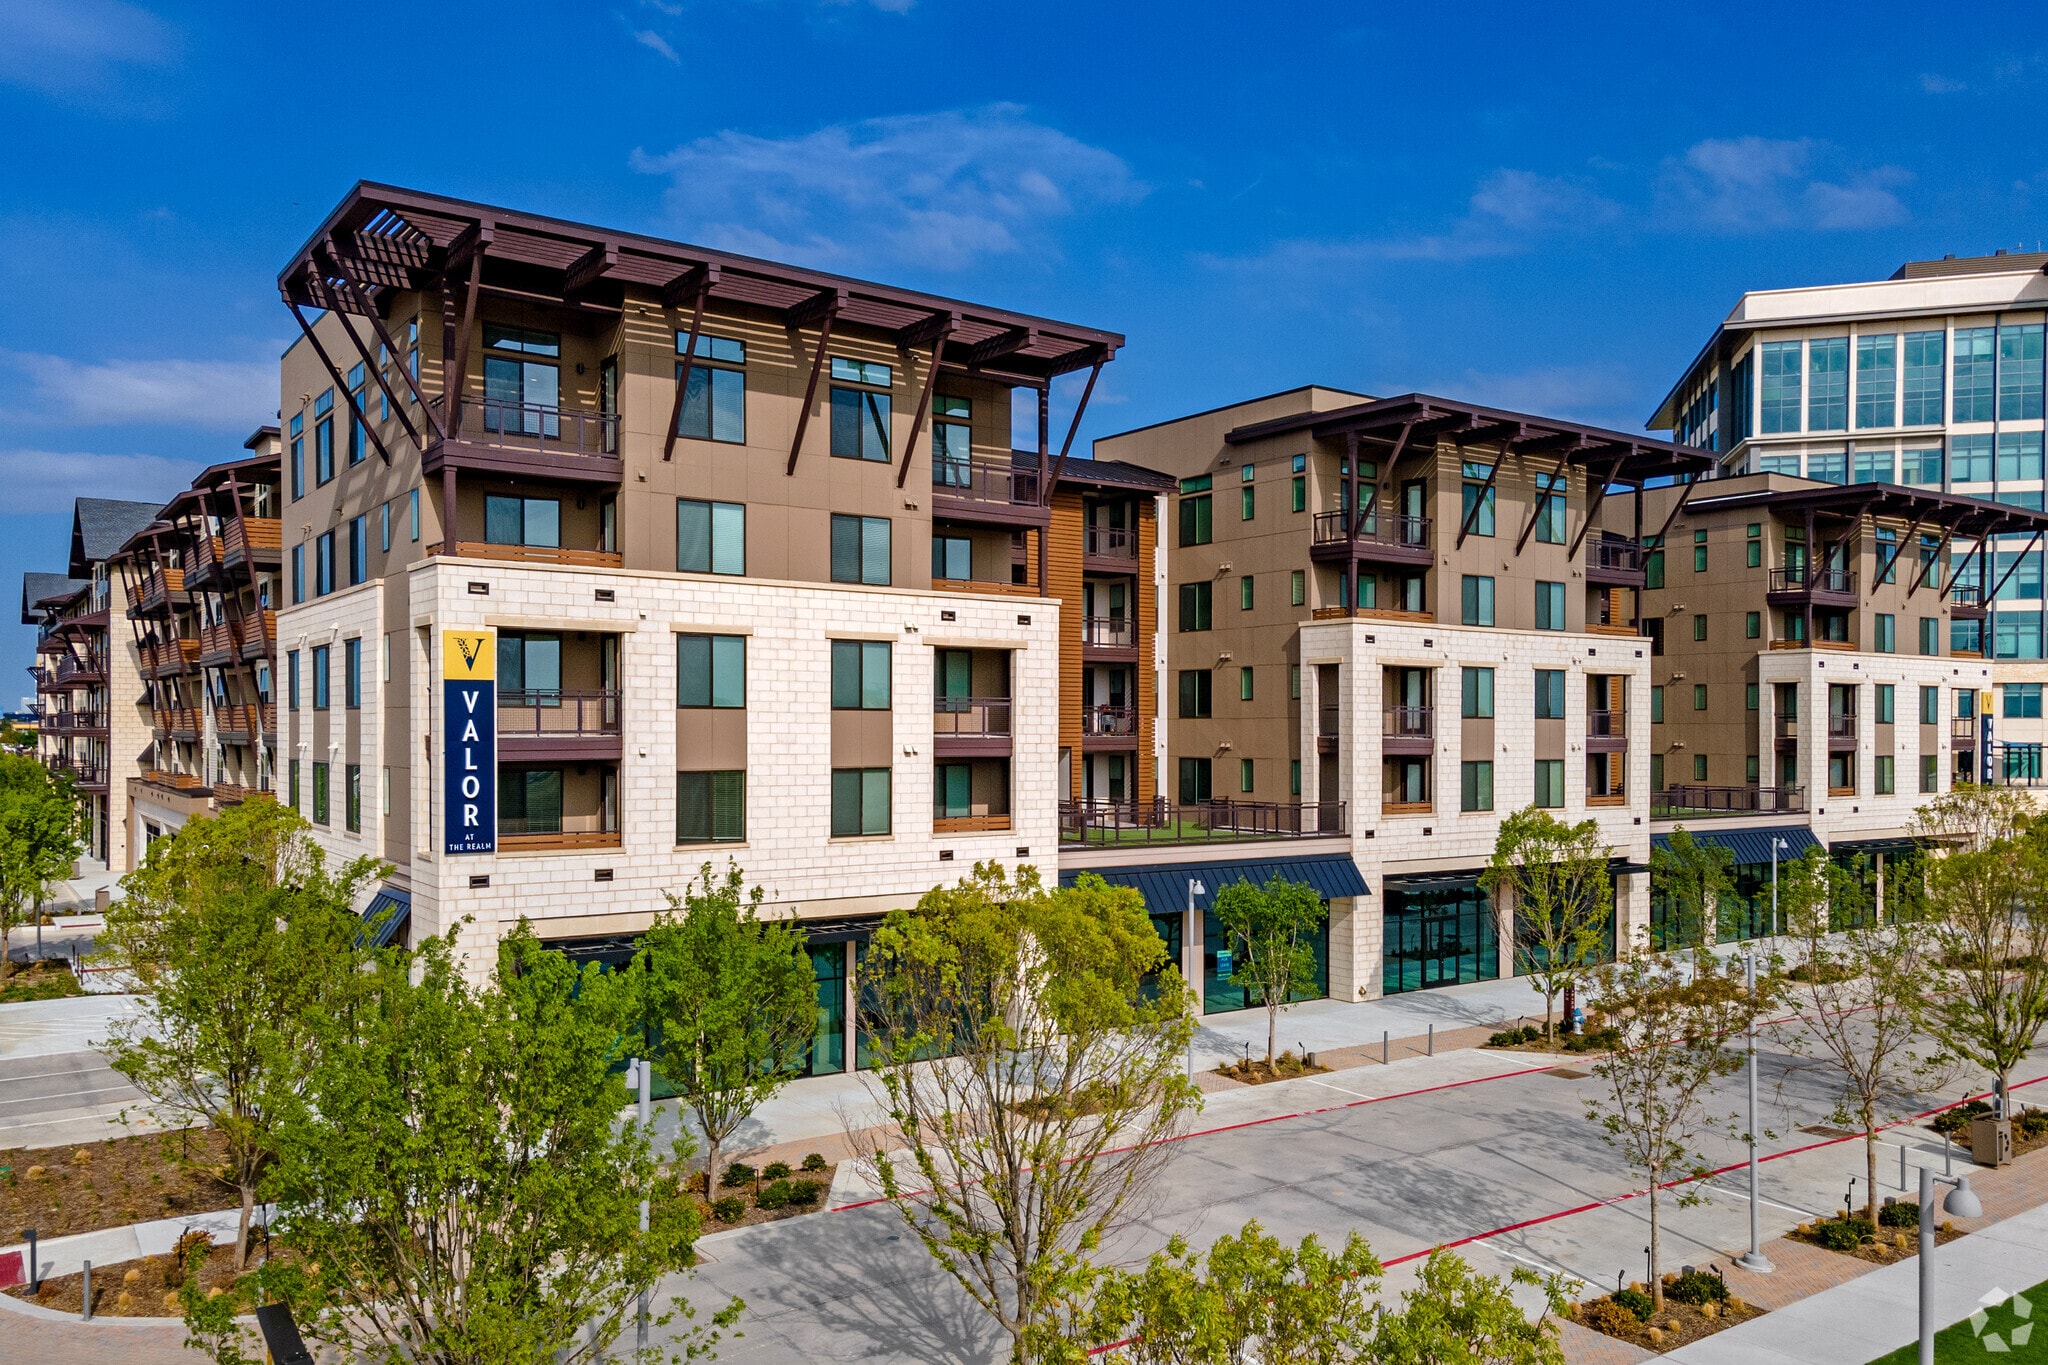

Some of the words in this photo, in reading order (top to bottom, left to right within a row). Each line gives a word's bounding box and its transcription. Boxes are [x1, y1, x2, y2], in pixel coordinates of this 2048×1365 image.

[461, 690, 480, 827] VALOR
[464, 833, 475, 841] AT
[449, 843, 464, 851] THE
[466, 842, 492, 850] REALM
